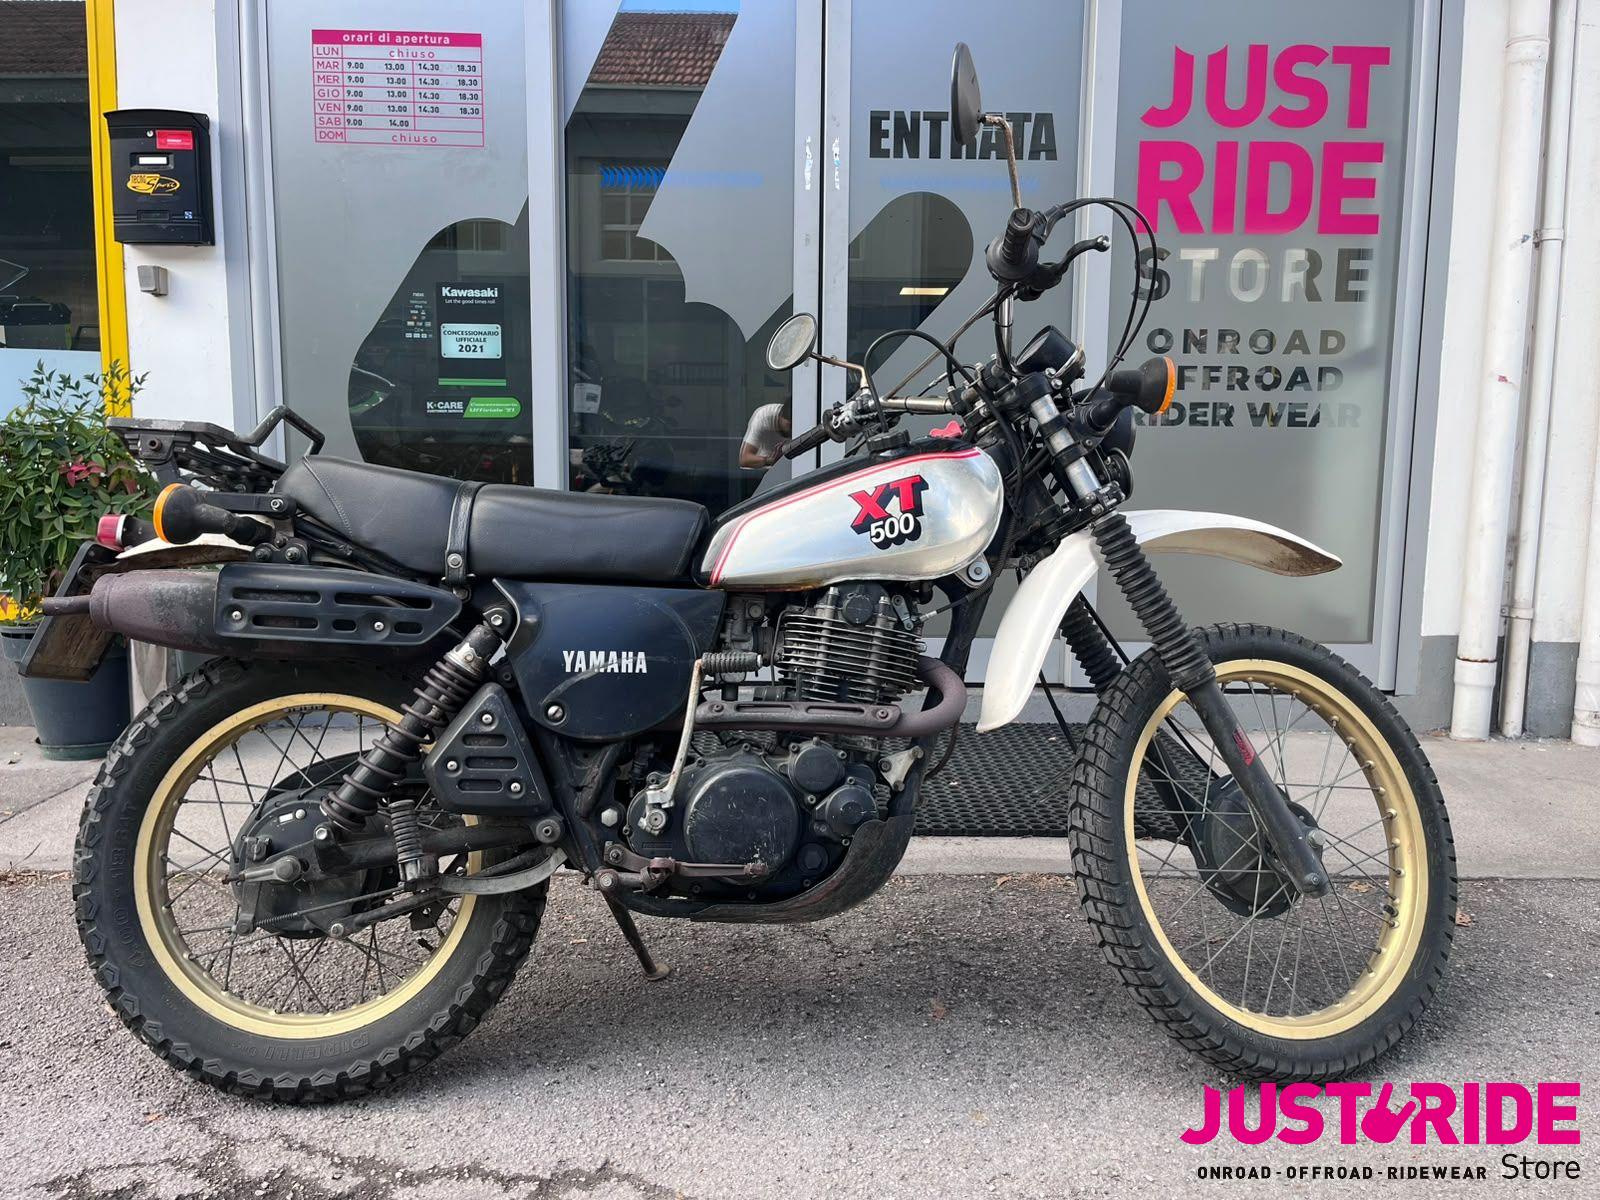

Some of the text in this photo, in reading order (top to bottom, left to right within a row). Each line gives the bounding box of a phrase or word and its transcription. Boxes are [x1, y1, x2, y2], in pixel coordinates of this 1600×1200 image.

[343, 32, 450, 45] orari di apertura
[316, 46, 435, 59] LUN chiuso
[316, 61, 477, 73] MAR 9.00 13.00 14.30 18.30
[317, 75, 478, 87] MER 9.00 13.00 14.30 18.30
[1140, 44, 1391, 128] JUST
[317, 89, 340, 98] GIO
[346, 90, 363, 98] 9.00
[418, 92, 440, 100] 14.30
[458, 93, 479, 101] 18.30
[317, 102, 480, 115] VEN 9.00 13.00 14.30 18.30
[318, 116, 409, 128] SAB 9.00 14.00
[319, 130, 437, 143] DOM chiuso
[1135, 140, 1384, 235] RIDE
[1130, 247, 1374, 303] STORE
[442, 286, 498, 297] Kawasaki
[1146, 328, 1346, 355] ONROAD
[458, 344, 484, 353] 2021
[1177, 365, 1344, 392] FFROAD
[1247, 402, 1362, 428] WEAR
[848, 475, 927, 532] XT
[870, 512, 917, 546] 500
[562, 650, 647, 674] YAMAHA
